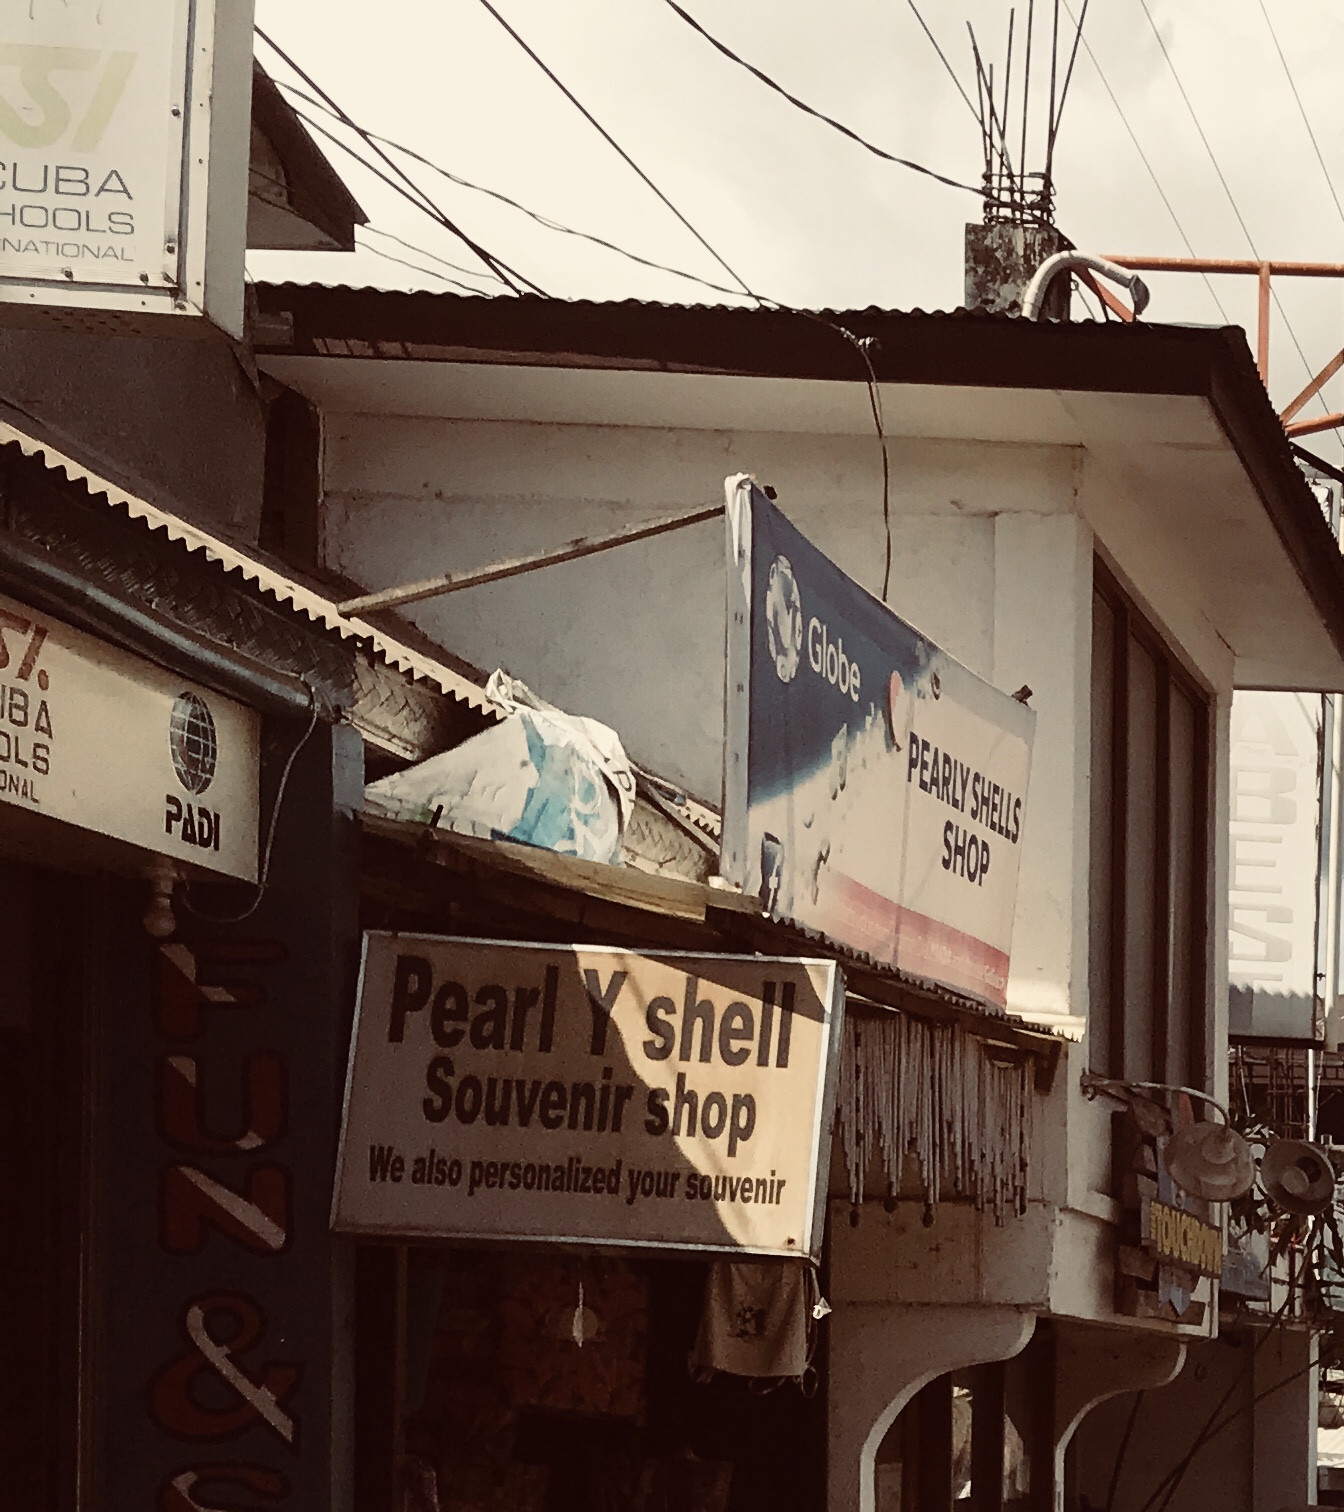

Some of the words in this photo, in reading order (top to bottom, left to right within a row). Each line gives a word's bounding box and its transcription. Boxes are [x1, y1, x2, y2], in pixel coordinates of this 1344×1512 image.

[807, 616, 862, 703] Globe
[165, 794, 220, 851] PADI
[907, 731, 970, 813] PEARLY
[971, 771, 1022, 844] SHELLS
[942, 819, 991, 887] SHOP
[389, 955, 558, 1052] Pearl
[583, 969, 627, 1055] Y
[643, 975, 796, 1068] shell
[423, 1056, 633, 1132] Souvenir
[644, 1072, 757, 1157] shop
[369, 1145, 404, 1183] We
[412, 1150, 462, 1185] also
[468, 1156, 622, 1196] personalized
[625, 1170, 680, 1205] your
[685, 1171, 786, 1205] souvenir
